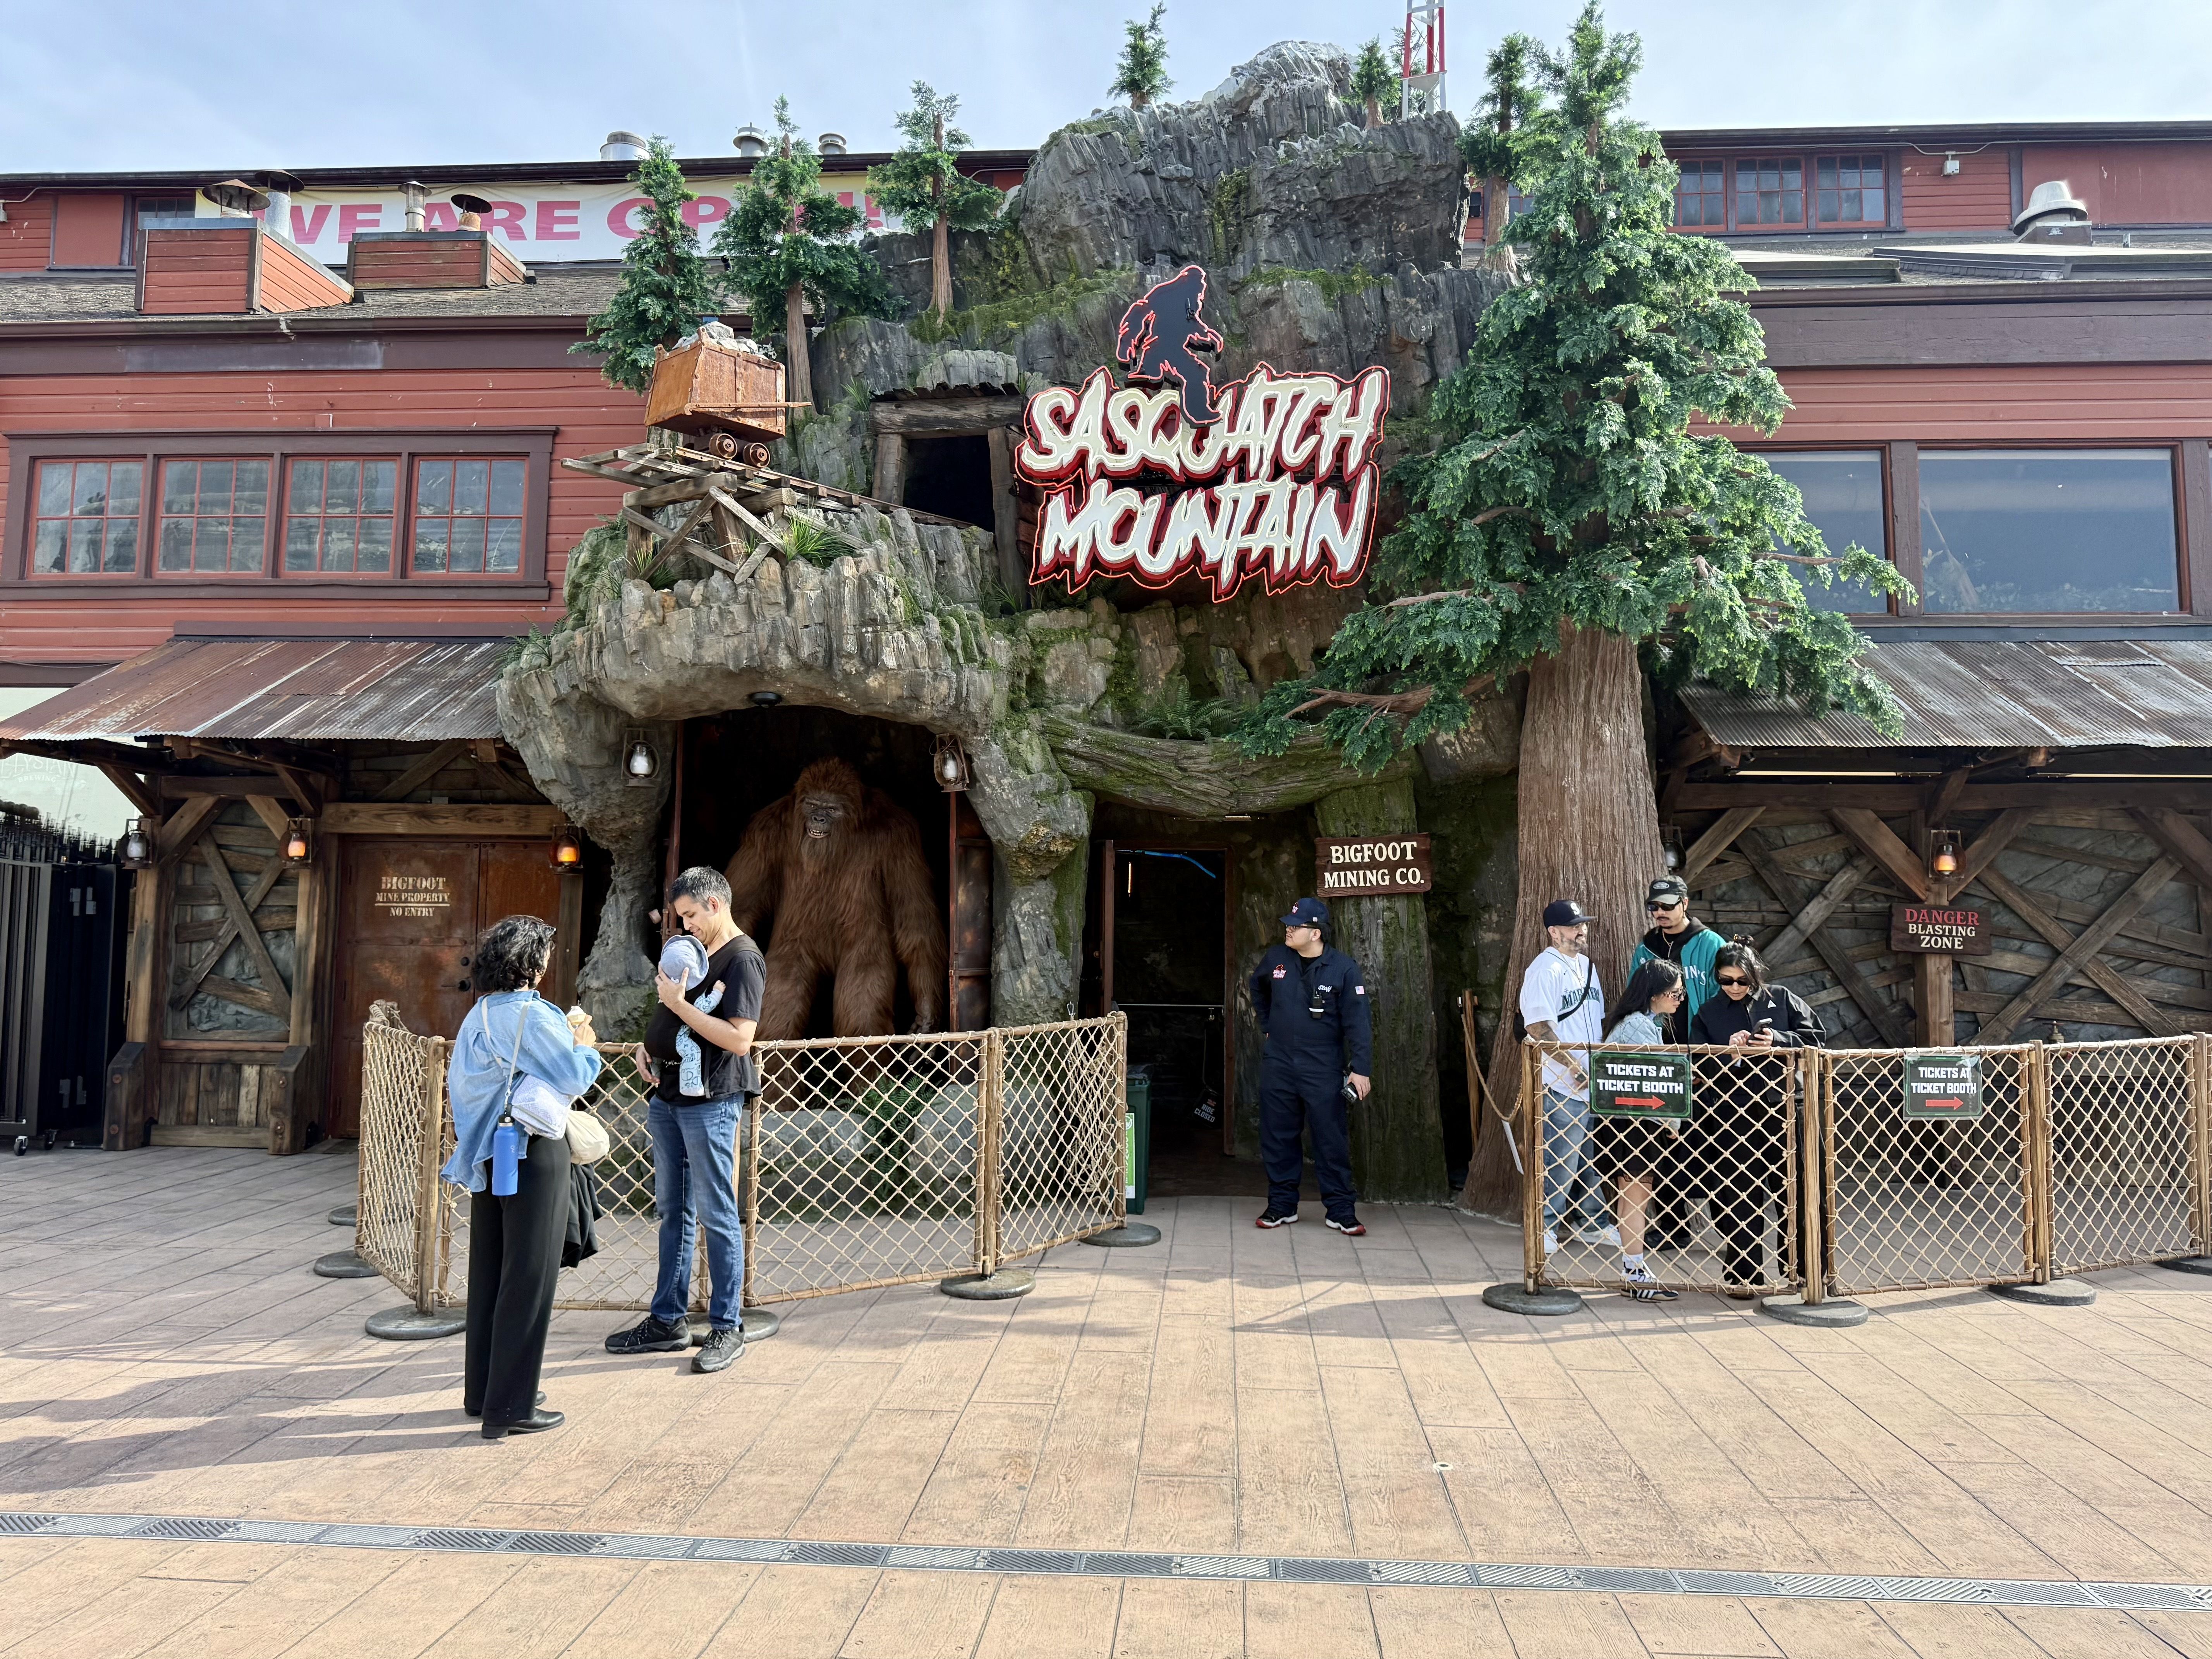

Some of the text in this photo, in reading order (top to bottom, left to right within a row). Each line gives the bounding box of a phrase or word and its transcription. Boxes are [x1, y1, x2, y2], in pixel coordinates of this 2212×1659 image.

[424, 199, 580, 241] ARE
[1020, 369, 1385, 482] SASQUATCH
[1039, 465, 1372, 591] MOUNTAIN
[19, 775, 57, 783] BREWING
[1330, 841, 1417, 864] BIGFOOT
[381, 876, 446, 890] BIGFOOT
[1324, 867, 1425, 888] MINING CO.
[376, 892, 450, 902] MINE PROPERTY
[390, 907, 434, 917] NO ENTRY
[1905, 908, 1979, 926] DANGER
[1908, 923, 1975, 937] BLASTING
[1920, 936, 1963, 949] ZONE
[1606, 1063, 1674, 1077] TICKETS AT
[1918, 1067, 1971, 1079] TICKETS AT
[1597, 1079, 1683, 1094] TICKET BOOTH
[1911, 1082, 1977, 1094] TICKET BOOTH
[1194, 1108, 1215, 1122] CLOSED
[1201, 1104, 1215, 1115] RIDE
